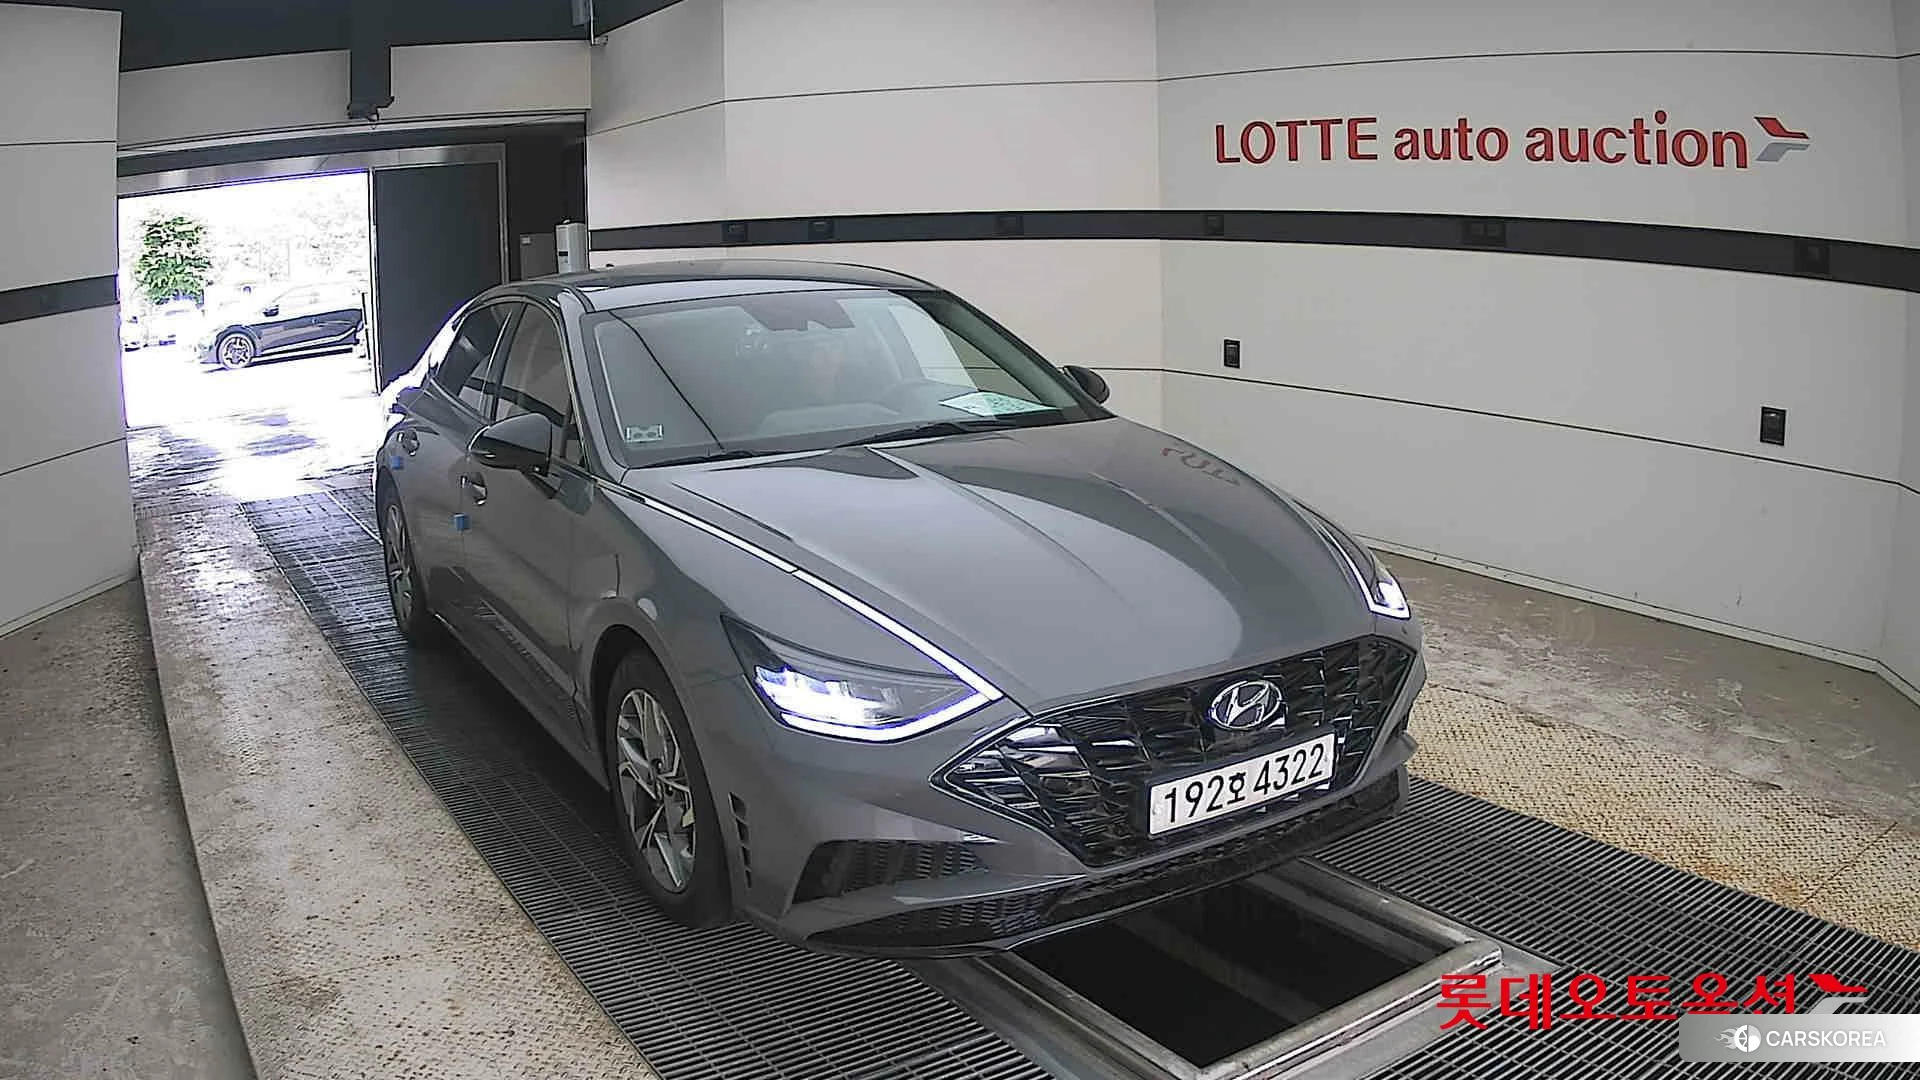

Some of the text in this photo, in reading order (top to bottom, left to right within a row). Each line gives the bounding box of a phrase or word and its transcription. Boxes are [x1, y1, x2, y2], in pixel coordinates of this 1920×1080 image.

[1215, 110, 1749, 169] LOTTE auto auction
[1164, 743, 1324, 823] 192호 4322
